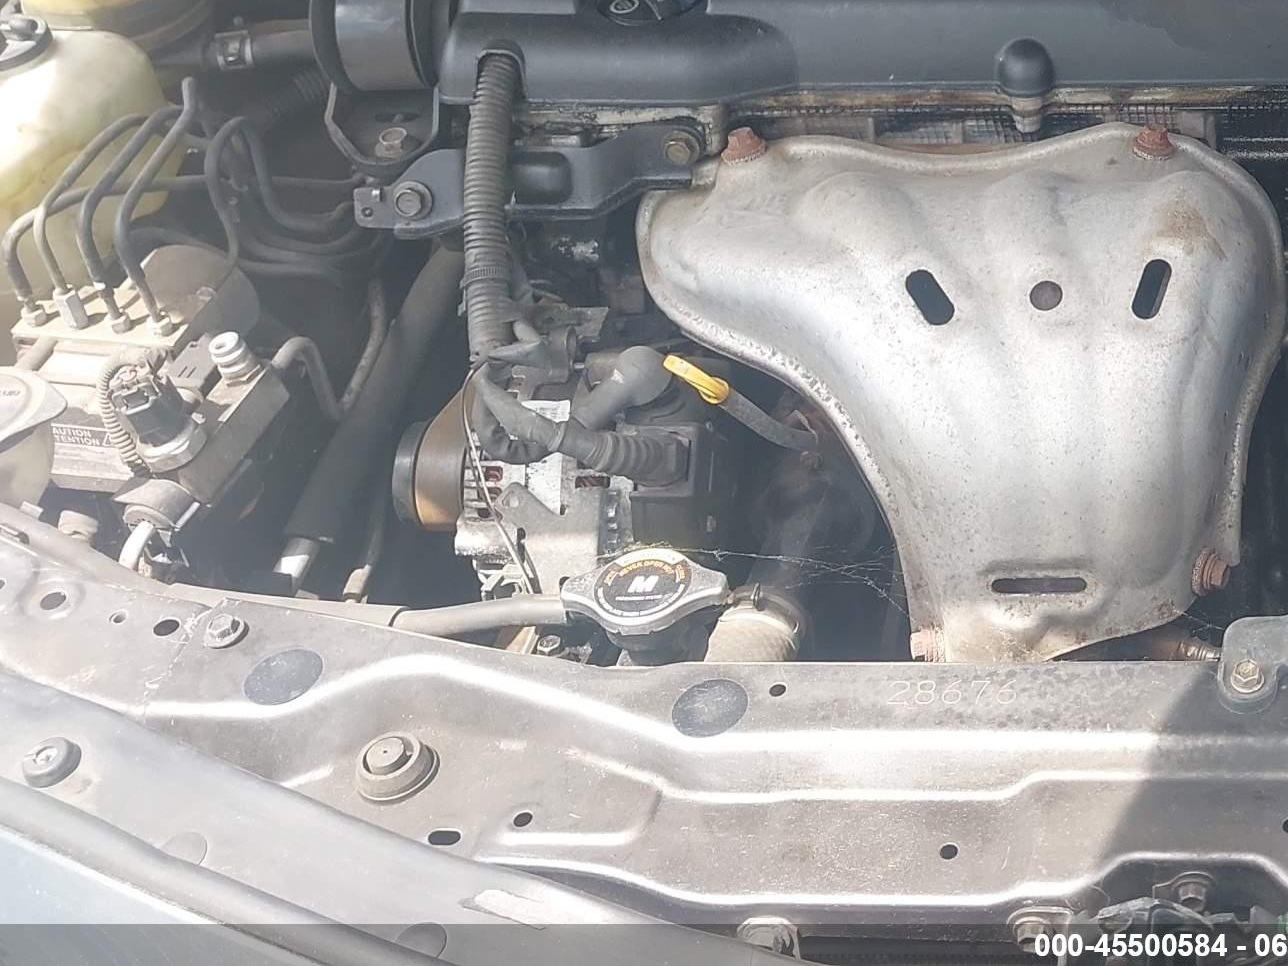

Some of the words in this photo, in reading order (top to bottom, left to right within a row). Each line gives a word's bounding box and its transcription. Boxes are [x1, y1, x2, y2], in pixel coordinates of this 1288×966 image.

[50, 426, 92, 438] AUTION
[52, 434, 101, 446] TENTION
[887, 679, 1017, 705] 28676
